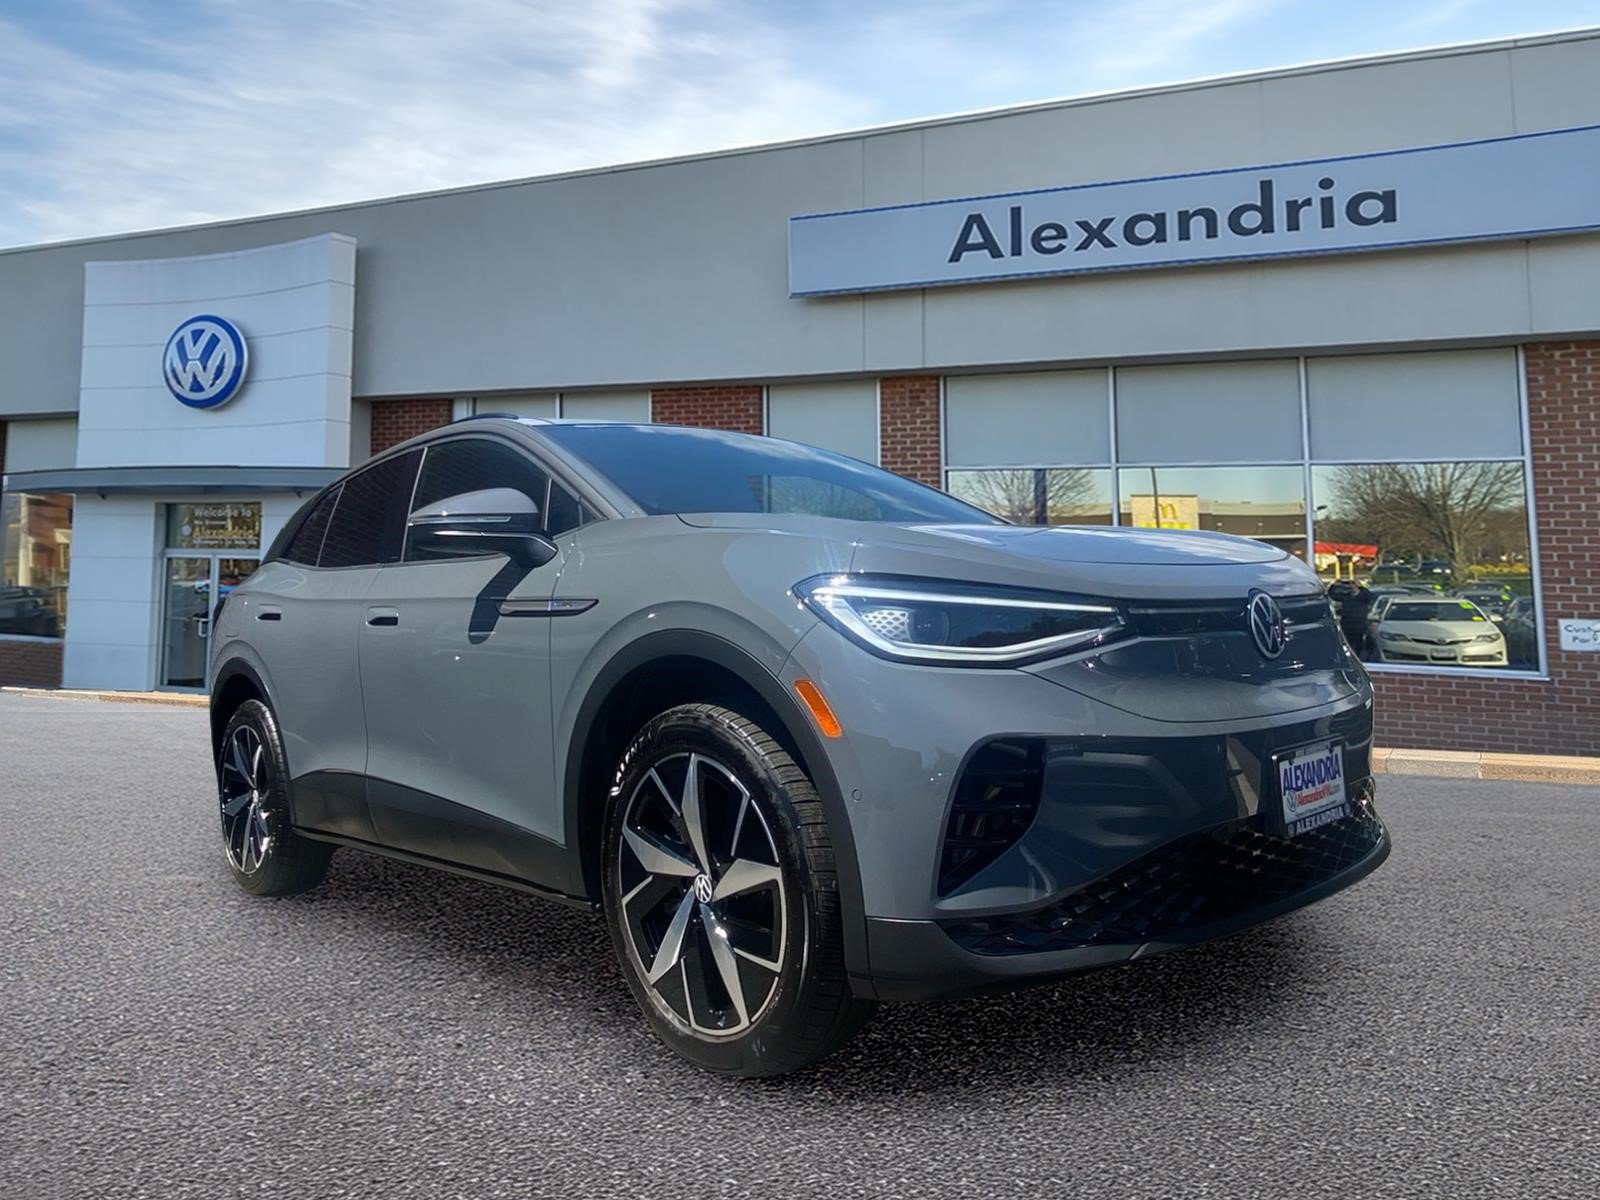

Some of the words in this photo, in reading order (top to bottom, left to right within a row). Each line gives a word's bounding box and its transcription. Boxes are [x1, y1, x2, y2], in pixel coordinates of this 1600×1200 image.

[948, 177, 1397, 263] Alexandria
[1283, 754, 1341, 796] ALEXANDRIA
[1297, 806, 1344, 834] ALEXANDRIA
